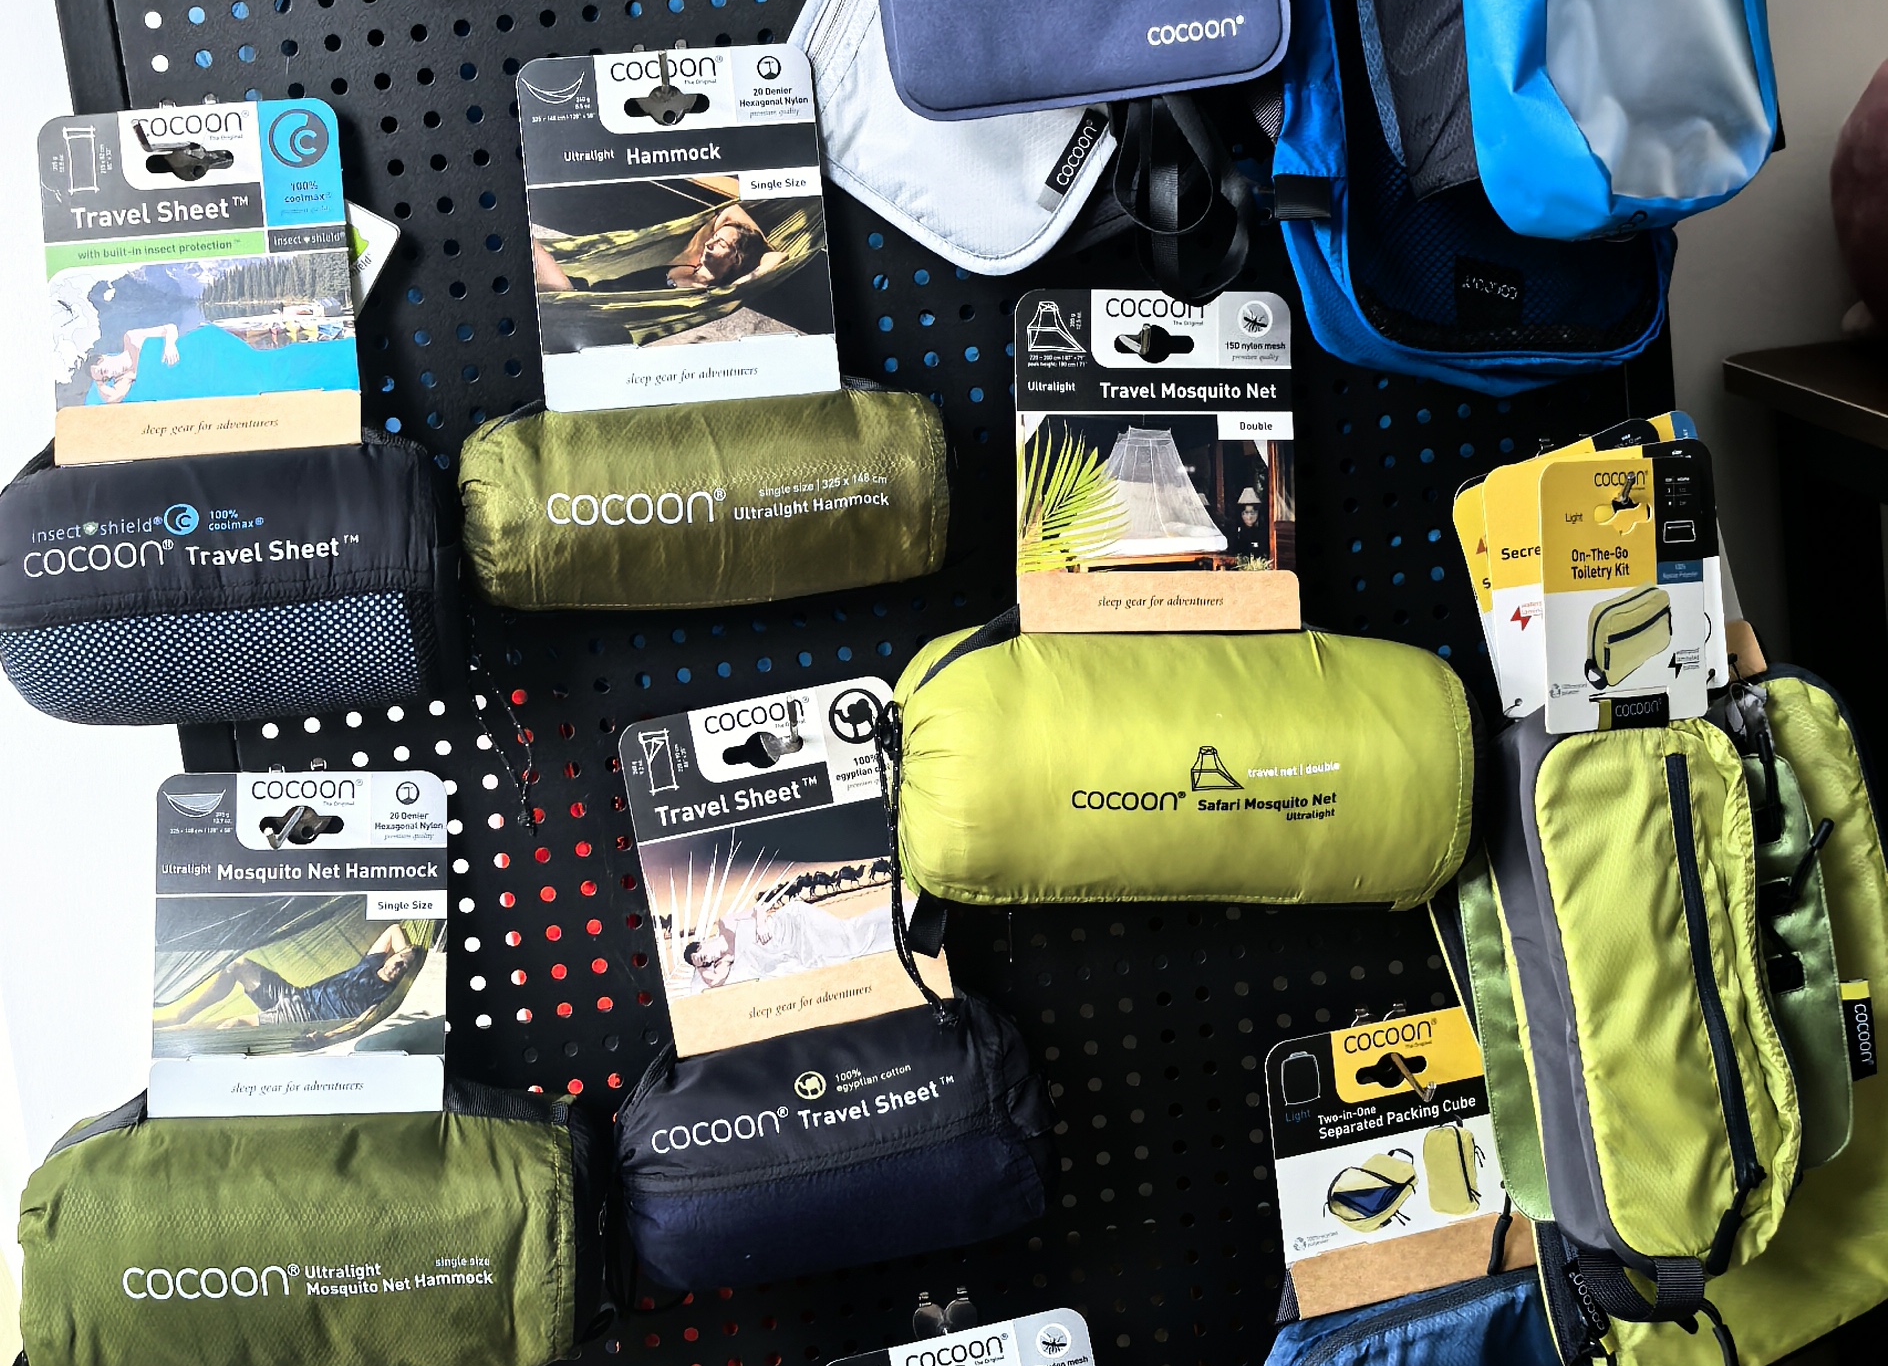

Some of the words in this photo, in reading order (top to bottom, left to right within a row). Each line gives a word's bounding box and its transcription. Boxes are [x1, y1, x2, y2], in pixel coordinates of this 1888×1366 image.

[563, 148, 615, 162] Ultralight
[627, 143, 721, 165] Hammock
[751, 180, 781, 190] Single
[784, 177, 807, 189] Size
[71, 208, 150, 228] Travel
[78, 249, 100, 260] with
[103, 247, 142, 258] built-in
[145, 244, 176, 256] insect
[1028, 381, 1076, 393] Ultralight
[1100, 382, 1155, 399] Travel
[1162, 382, 1241, 402] Mosquito
[1246, 383, 1277, 399] Net
[1239, 421, 1273, 431] Double
[209, 509, 238, 520] 100%
[733, 499, 809, 522] Ultralight
[813, 492, 890, 513] Hammock
[1565, 513, 1583, 524] Light
[185, 539, 261, 566] Travel
[1571, 546, 1629, 562] On-The-Go
[1571, 563, 1612, 580] Toiletry
[1615, 562, 1630, 577] Kit
[1248, 767, 1278, 777] travel
[1280, 766, 1297, 776] net
[1305, 761, 1340, 774] double
[655, 794, 730, 827] Travel
[1197, 797, 1241, 812] Safari
[1244, 797, 1308, 812] Mosquito
[1312, 792, 1337, 806] Net
[1286, 808, 1335, 821] Ultralight
[162, 864, 211, 875] Ultralight
[217, 864, 302, 883] Mosquito
[308, 864, 340, 879] Net
[346, 862, 438, 879] Hammock
[377, 901, 409, 912] Single
[412, 900, 433, 911] Size
[775, 1002, 797, 1016] gear
[835, 1067, 862, 1082] 100%
[836, 1073, 879, 1094] egyptian
[881, 1064, 912, 1081] cotton
[798, 1099, 870, 1131] Travel
[1318, 1105, 1376, 1125] Two-in-One
[1318, 1115, 1384, 1139] Separated
[1387, 1105, 1440, 1126] Packing
[1443, 1096, 1476, 1112] Cube
[435, 1255, 467, 1268] single
[305, 1262, 382, 1280] Ultralight
[306, 1279, 379, 1298] Mosquito
[383, 1276, 411, 1292] Net
[415, 1271, 494, 1288] Hammock
